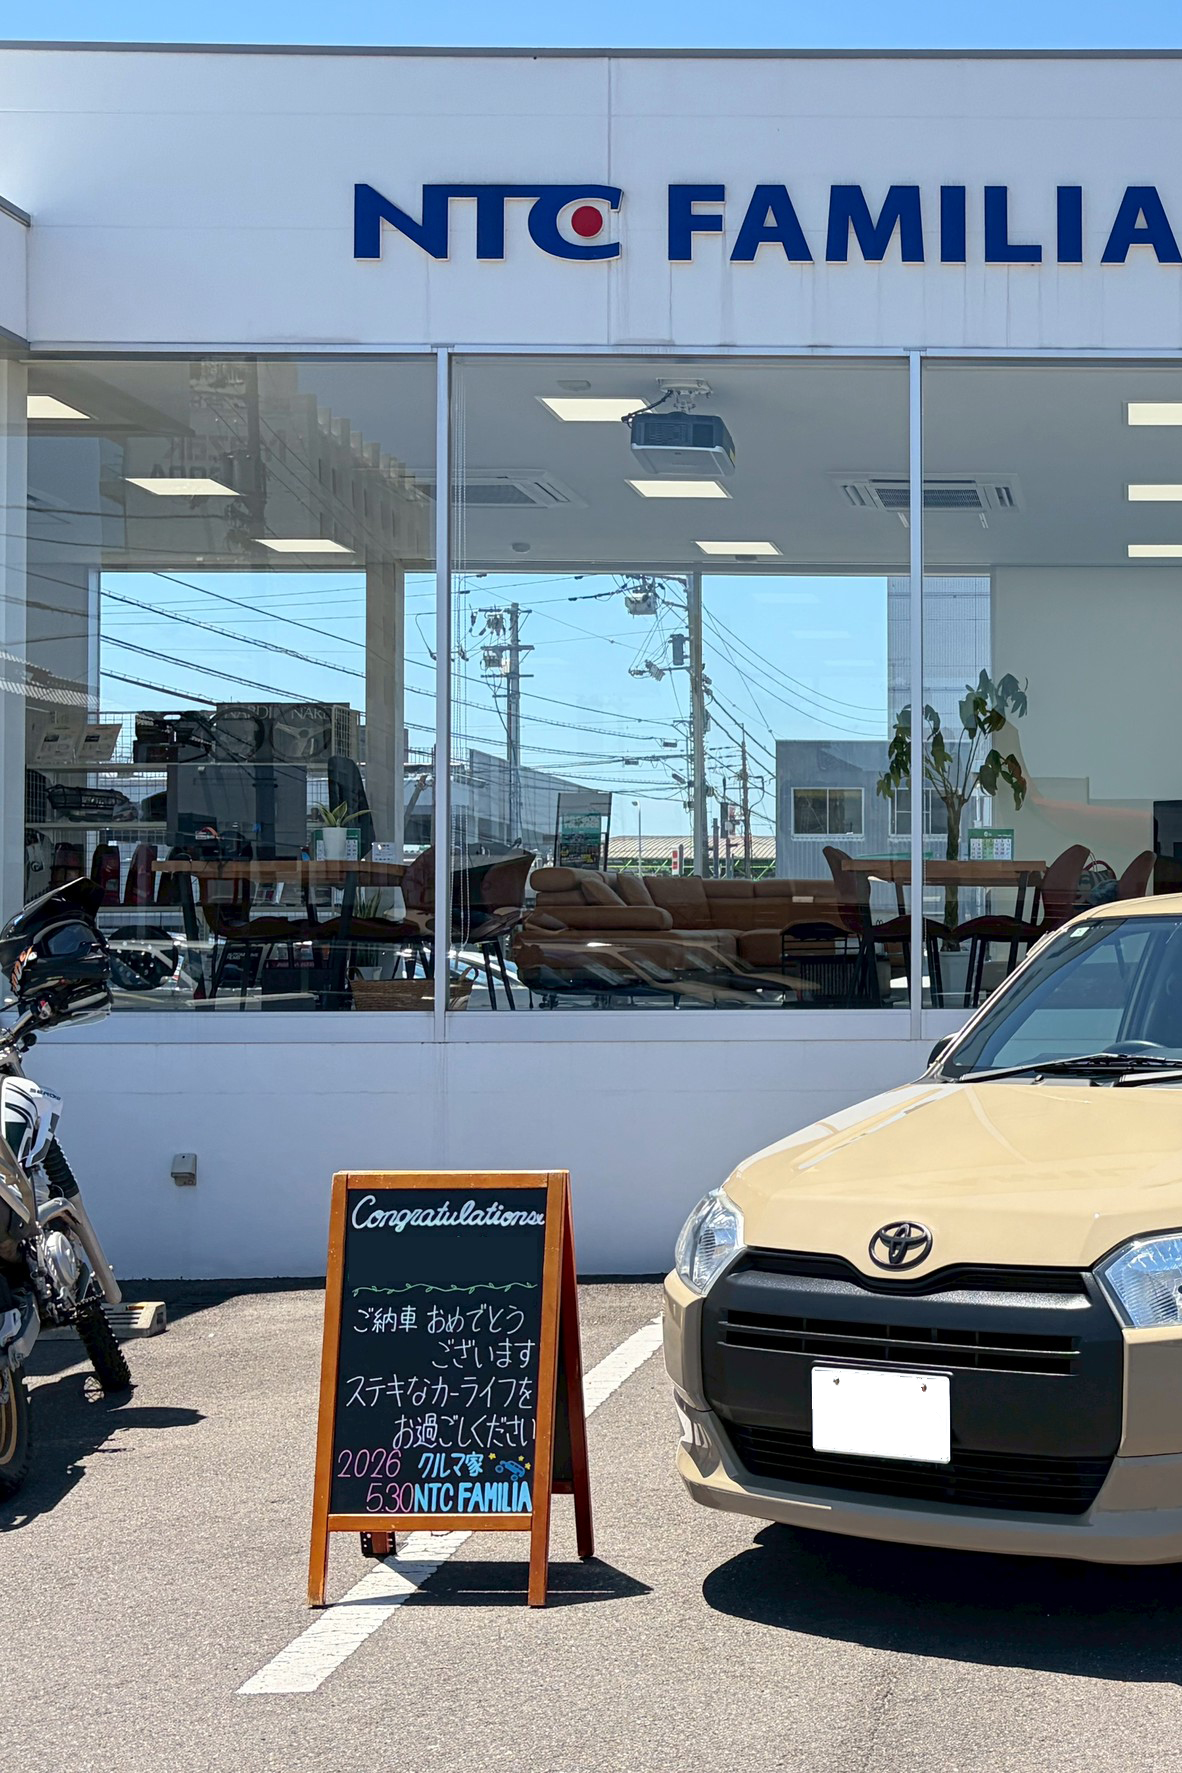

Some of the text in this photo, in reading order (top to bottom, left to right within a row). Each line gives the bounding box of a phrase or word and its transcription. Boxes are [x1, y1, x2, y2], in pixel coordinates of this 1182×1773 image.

[354, 183, 622, 260] NTC
[353, 1303, 525, 1335] ご納車 おめでとう
[432, 1338, 536, 1368] ございます
[346, 1374, 533, 1409] ステキなカーライフを
[393, 1413, 536, 1449] お過ごしください
[338, 1448, 402, 1478] 2026
[418, 1451, 484, 1478] クルマ家
[414, 1482, 454, 1513] NTC
[457, 1481, 533, 1513] FAMILIA
